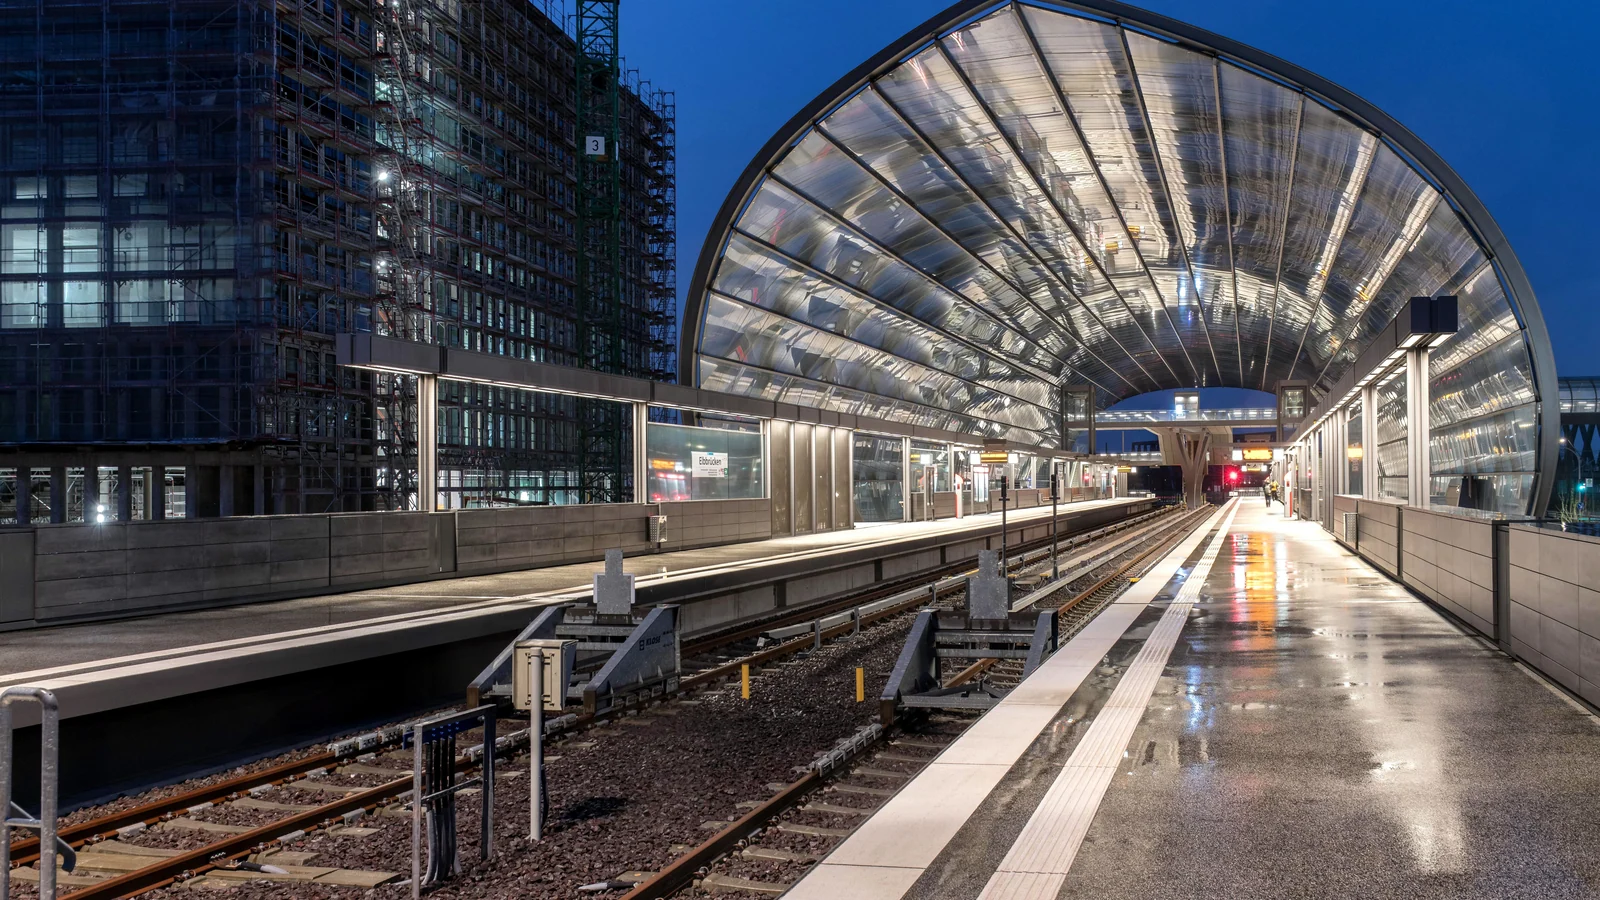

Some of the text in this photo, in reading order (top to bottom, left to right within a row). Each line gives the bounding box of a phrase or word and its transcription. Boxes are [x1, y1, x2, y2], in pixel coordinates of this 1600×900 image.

[592, 140, 599, 152] 3
[699, 457, 722, 466] Elbbrücken
[646, 635, 661, 646] KLOSE
